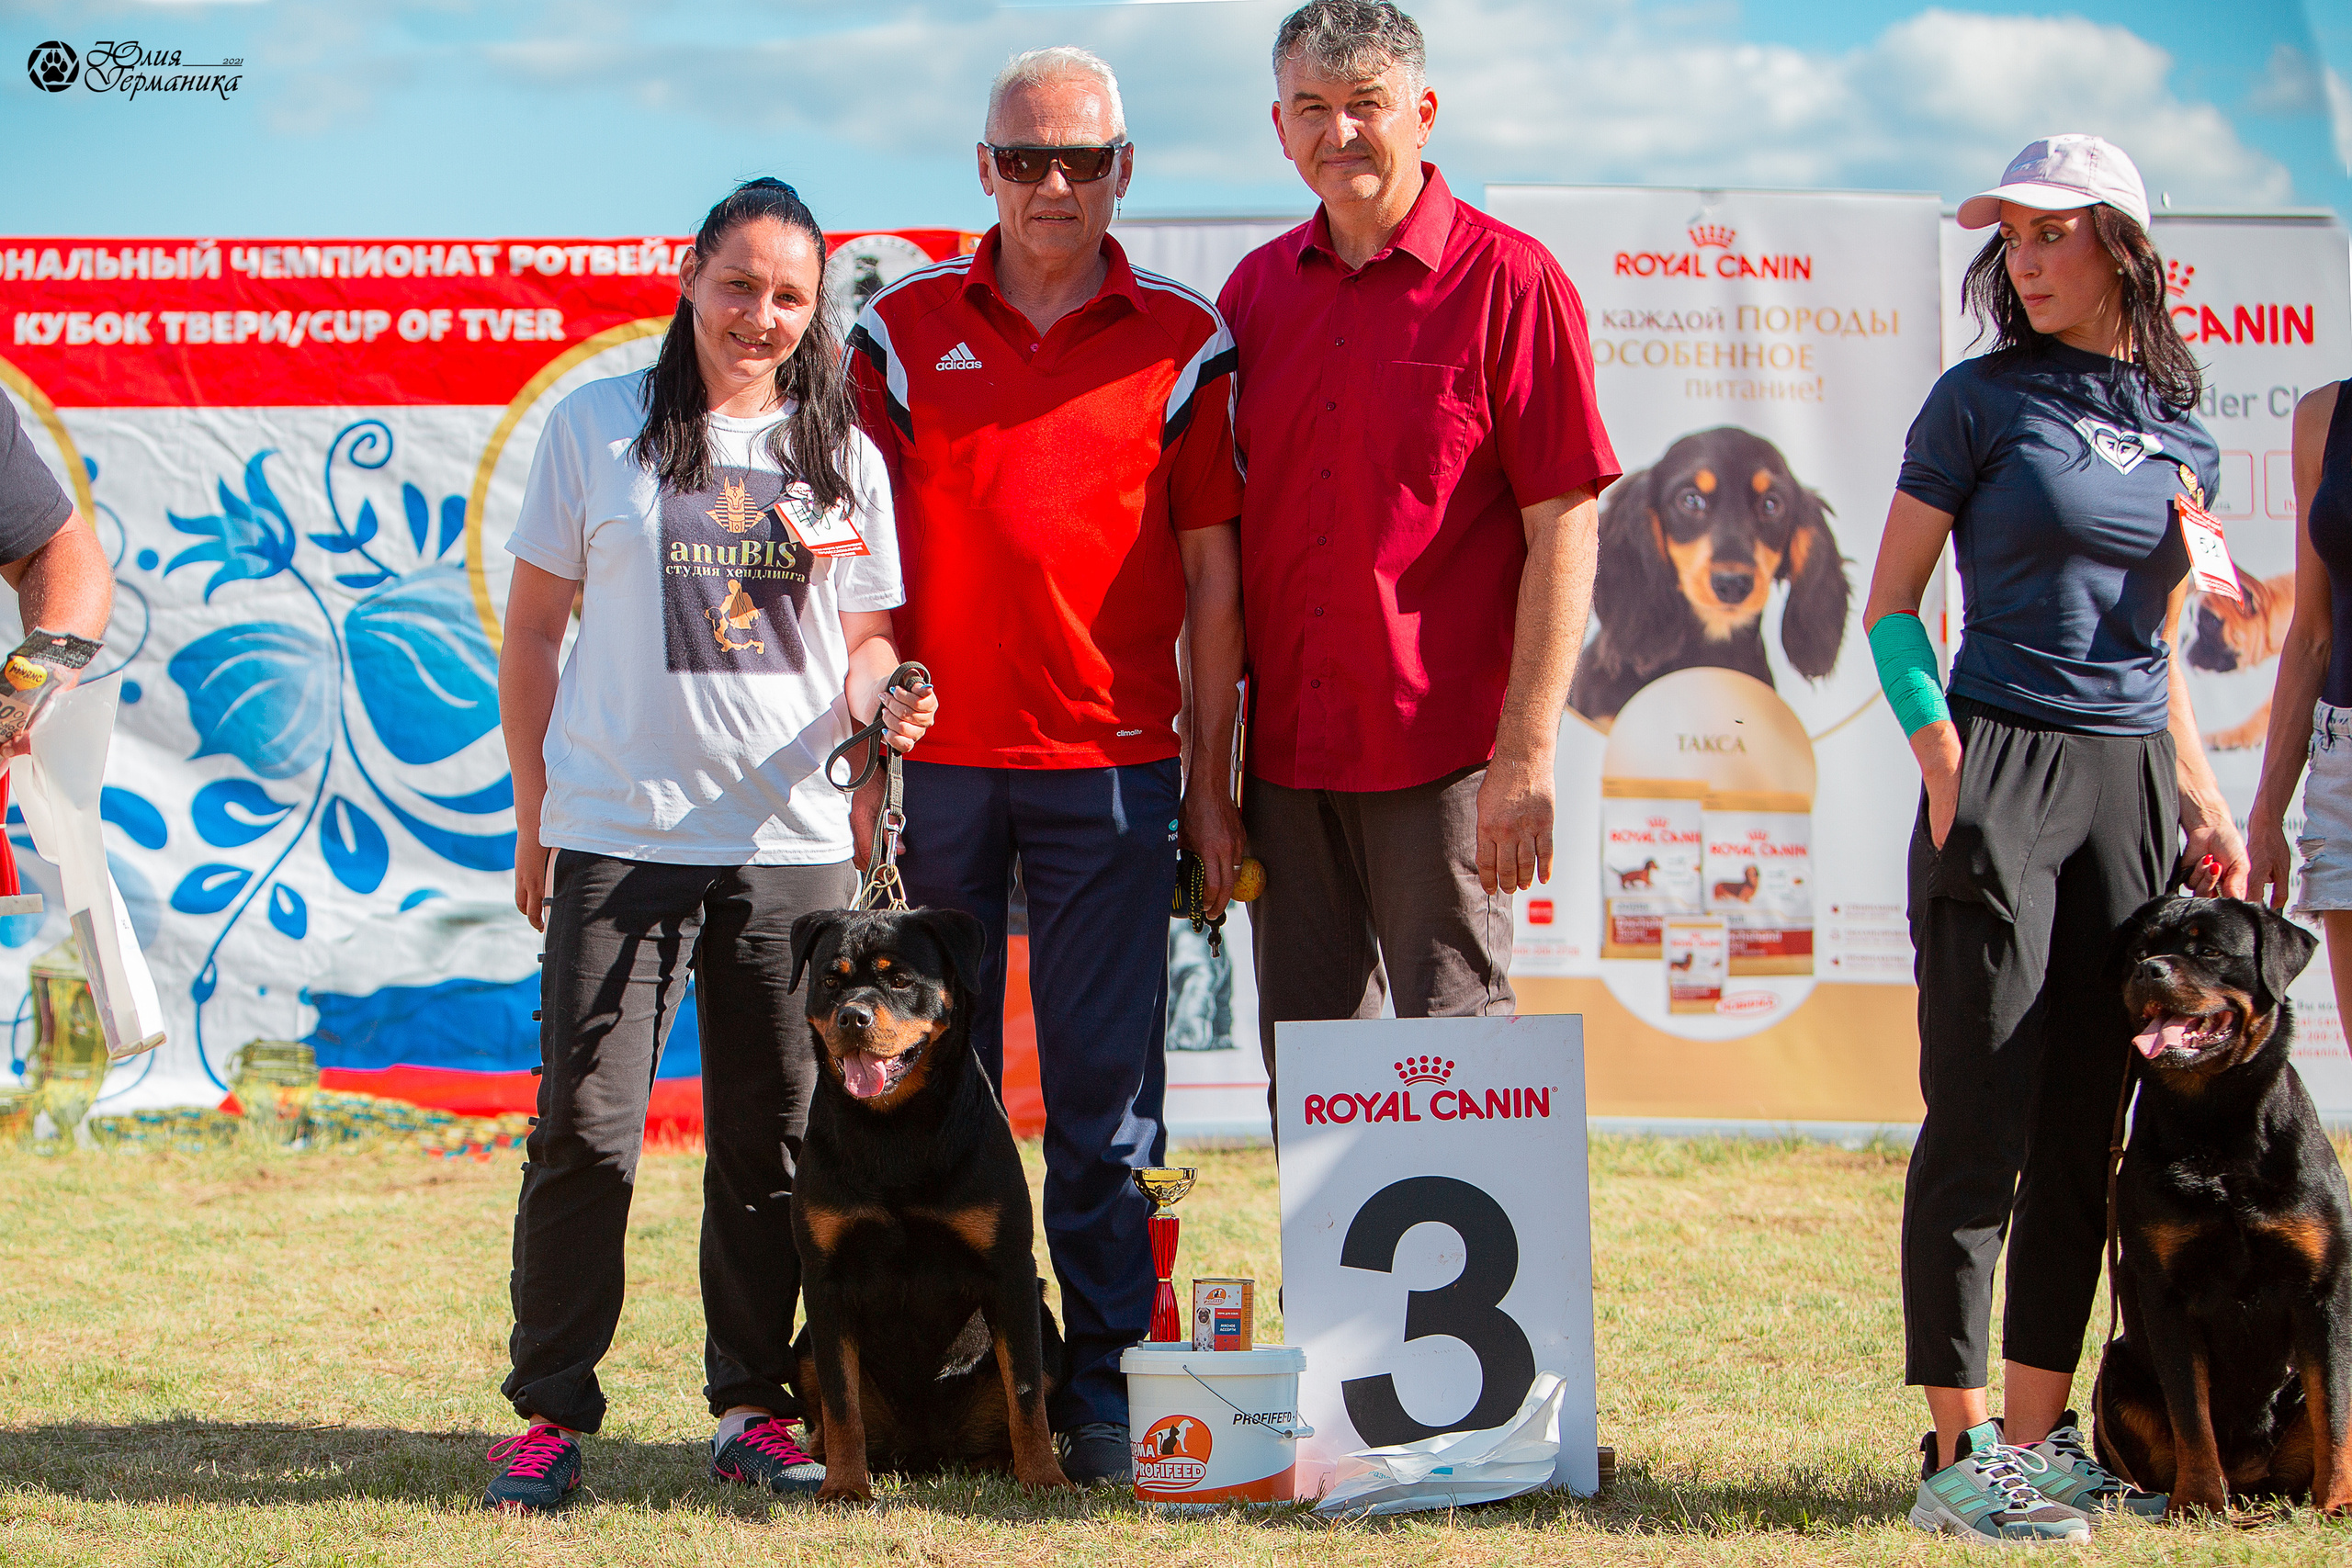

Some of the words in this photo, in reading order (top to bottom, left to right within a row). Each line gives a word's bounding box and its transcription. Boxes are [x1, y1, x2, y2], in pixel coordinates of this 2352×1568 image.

[0, 238, 222, 281] НАЛЬНЫЙ
[230, 244, 503, 279] ЧЕМПИОНАТ
[1614, 252, 1707, 278] ROYAL
[1715, 254, 1813, 281] CANIN
[13, 310, 154, 346] КУБОК
[158, 308, 392, 348] ТВЕРИ/CUP
[397, 308, 454, 343] OF
[459, 308, 567, 343] TVER
[1601, 306, 1725, 333] каждой
[1736, 305, 1900, 339] ПОРОДЫ
[935, 358, 983, 371] adidas
[1591, 338, 1815, 371] ОСОБЕННОЕ
[1685, 378, 1824, 401] питание!
[670, 539, 798, 569] anuBIS
[665, 563, 720, 578] студия
[726, 564, 806, 583] хендлинга
[1676, 734, 1747, 755] ТАКСА
[1304, 1090, 1421, 1125] ROYAL
[1430, 1086, 1550, 1121] CANIN
[1340, 1175, 1536, 1449] 3
[1135, 1459, 1205, 1479] PROFIFEED
